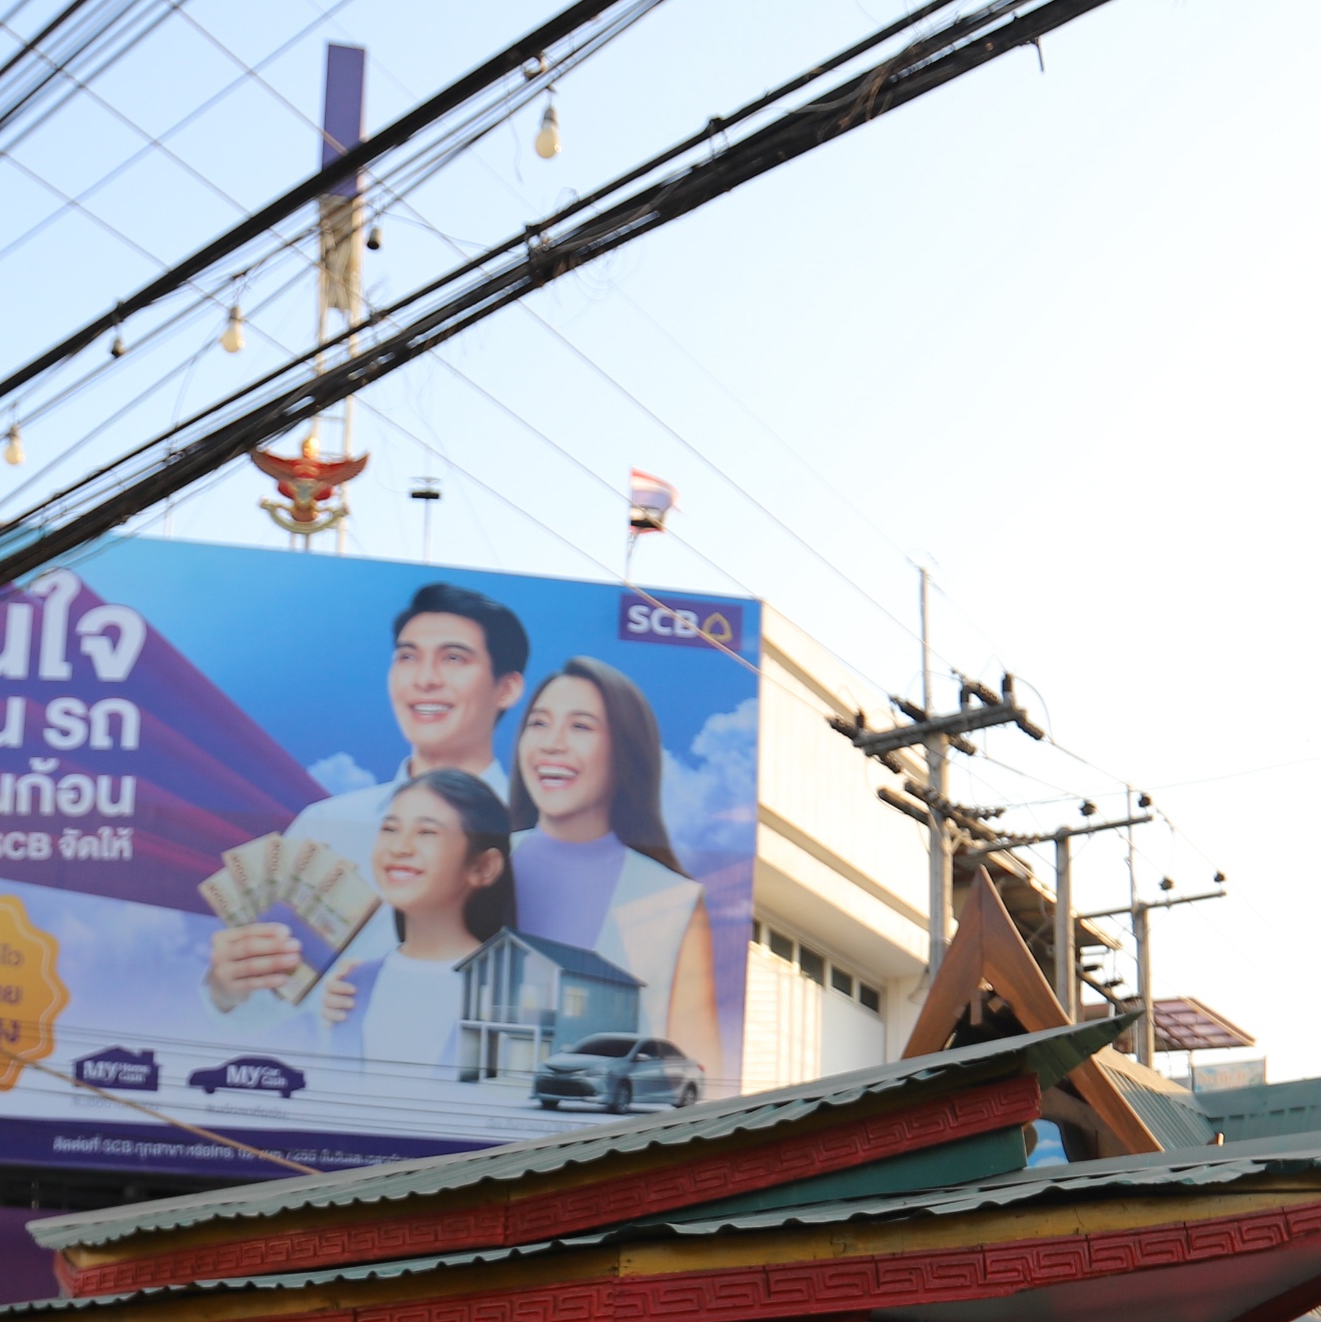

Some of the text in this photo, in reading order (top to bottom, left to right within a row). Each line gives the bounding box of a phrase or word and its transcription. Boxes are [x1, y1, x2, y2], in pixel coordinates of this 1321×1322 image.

[627, 604, 699, 639] SCB
[43, 696, 141, 752] รถ
[227, 1064, 262, 1088] My
